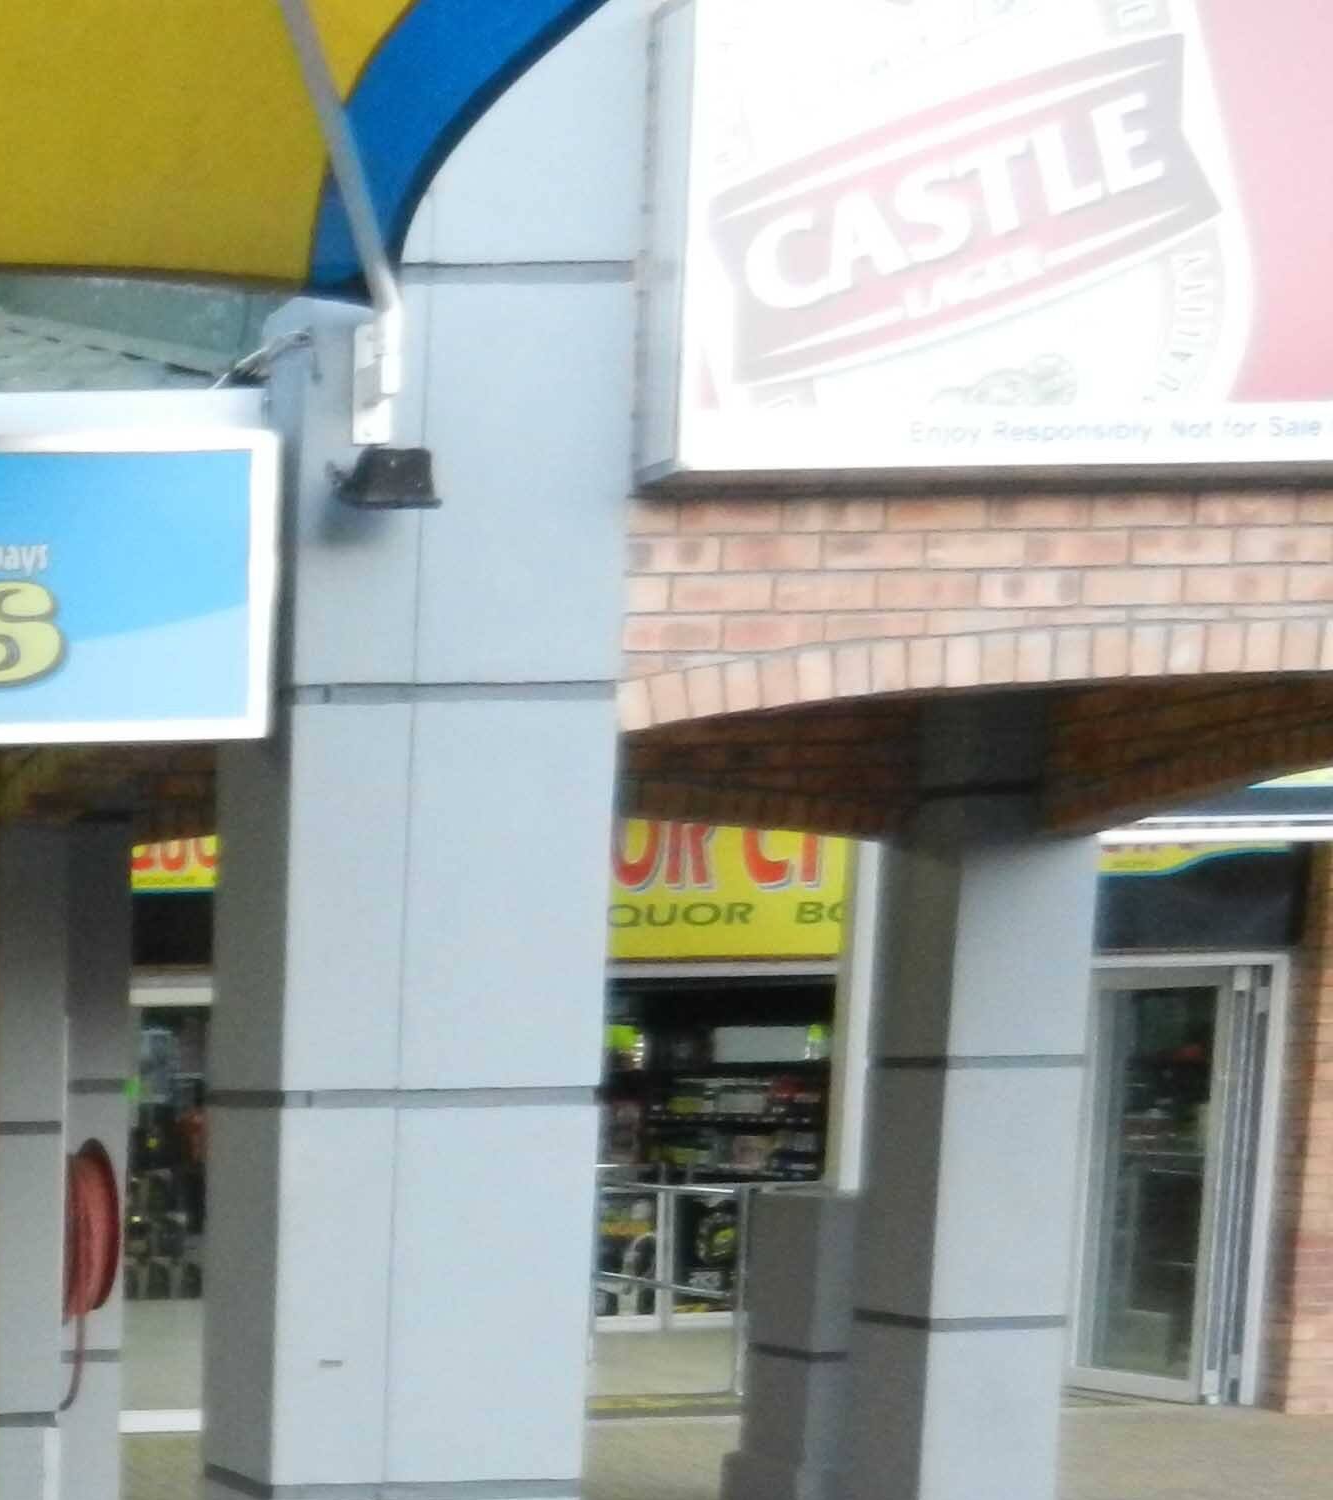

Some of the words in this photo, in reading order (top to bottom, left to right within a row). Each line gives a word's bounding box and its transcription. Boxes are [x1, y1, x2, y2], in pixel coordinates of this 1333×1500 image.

[744, 91, 1166, 310] CASTLE
[909, 419, 982, 448] Enjoy
[1171, 416, 1213, 441] Not
[1268, 414, 1323, 438] Sale
